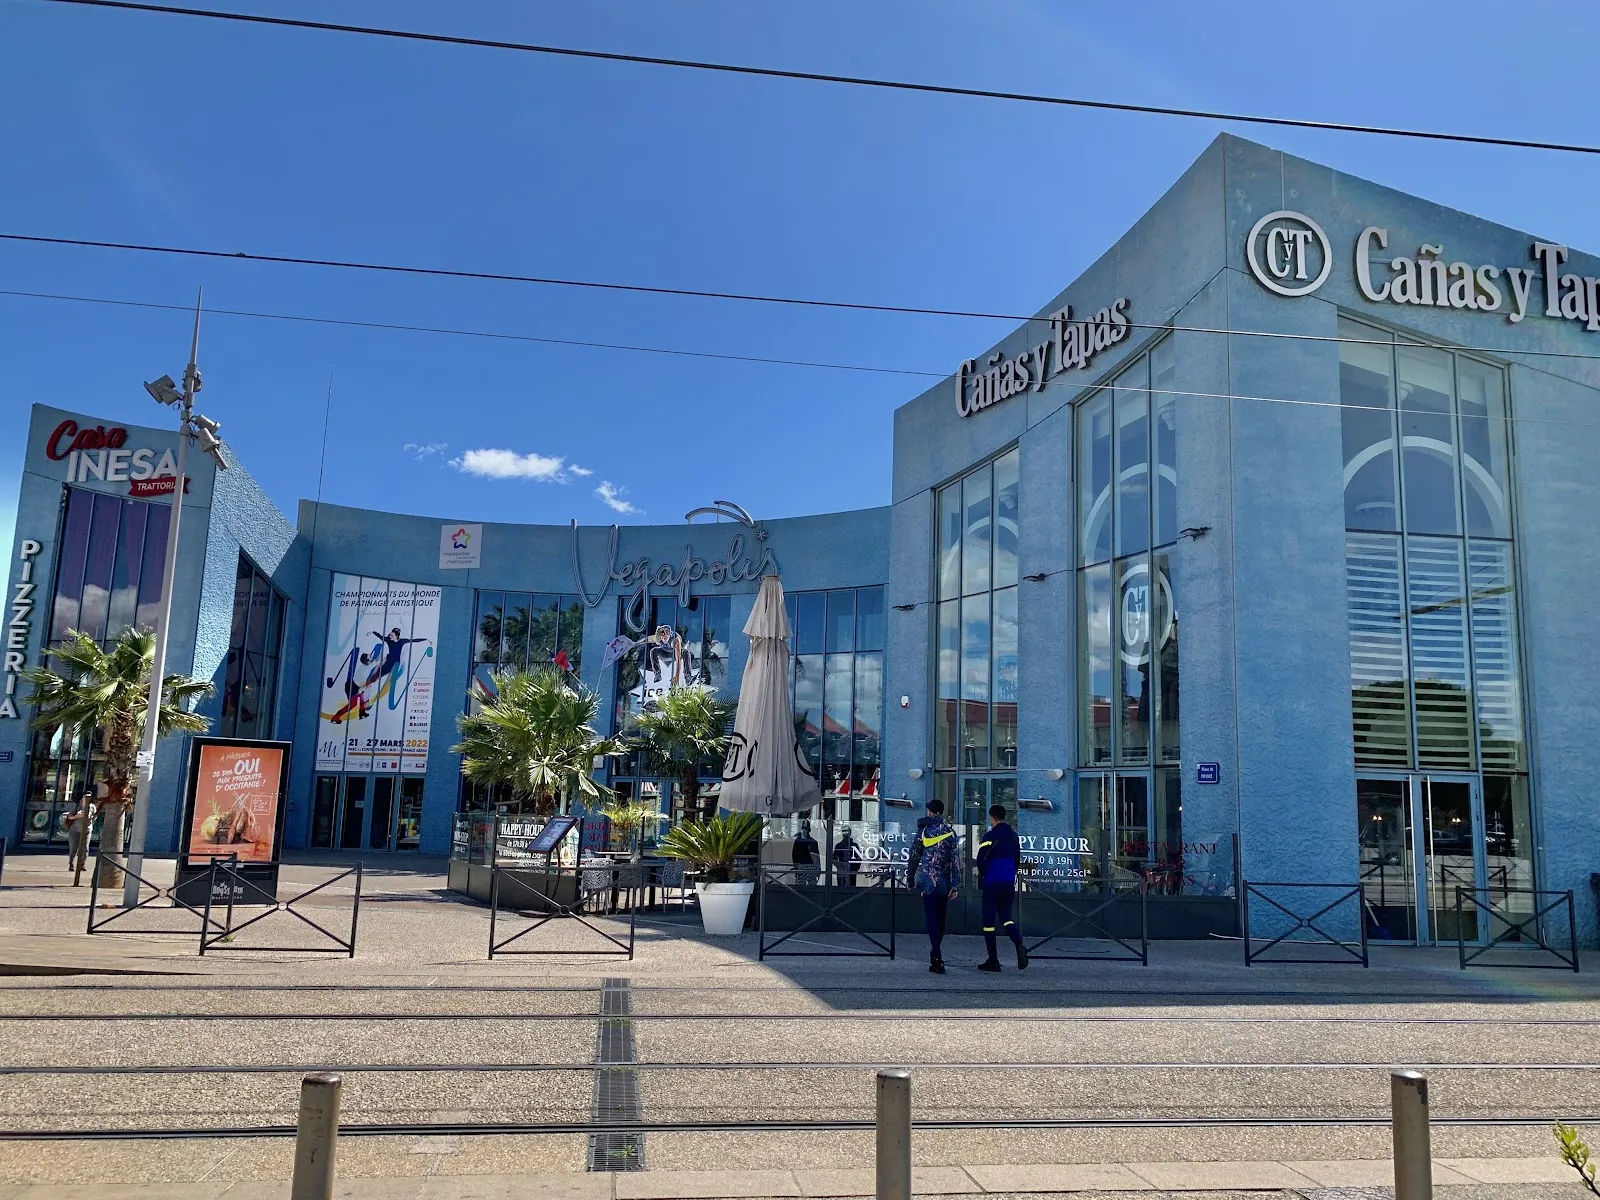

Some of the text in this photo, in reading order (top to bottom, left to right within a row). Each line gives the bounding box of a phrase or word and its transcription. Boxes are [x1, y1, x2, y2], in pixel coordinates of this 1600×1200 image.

[1356, 226, 1502, 311] Cañas
[1507, 267, 1535, 323] y
[955, 298, 1130, 418] Cañas y Tapas
[46, 420, 128, 460] Casa
[66, 447, 178, 483] INESA
[137, 481, 176, 491] TRATTORI
[335, 590, 441, 598] CHAMPIONNATS DU MONDE
[390, 599, 434, 607] ARTISTIQUE
[0, 540, 41, 718] PIZZERIA
[348, 738, 428, 748] 21 27 MARS 2022
[233, 757, 261, 775] OUI
[216, 773, 263, 784] AUX PRODUITS
[500, 823, 523, 836] HAPPY
[862, 830, 907, 843] Ouvert
[1043, 836, 1090, 852] HOUR
[851, 845, 910, 861] NON-S
[1019, 855, 1073, 865] 7h30 à 19h
[1017, 868, 1029, 876] au
[1031, 868, 1050, 877] prix
[1053, 868, 1064, 876] du
